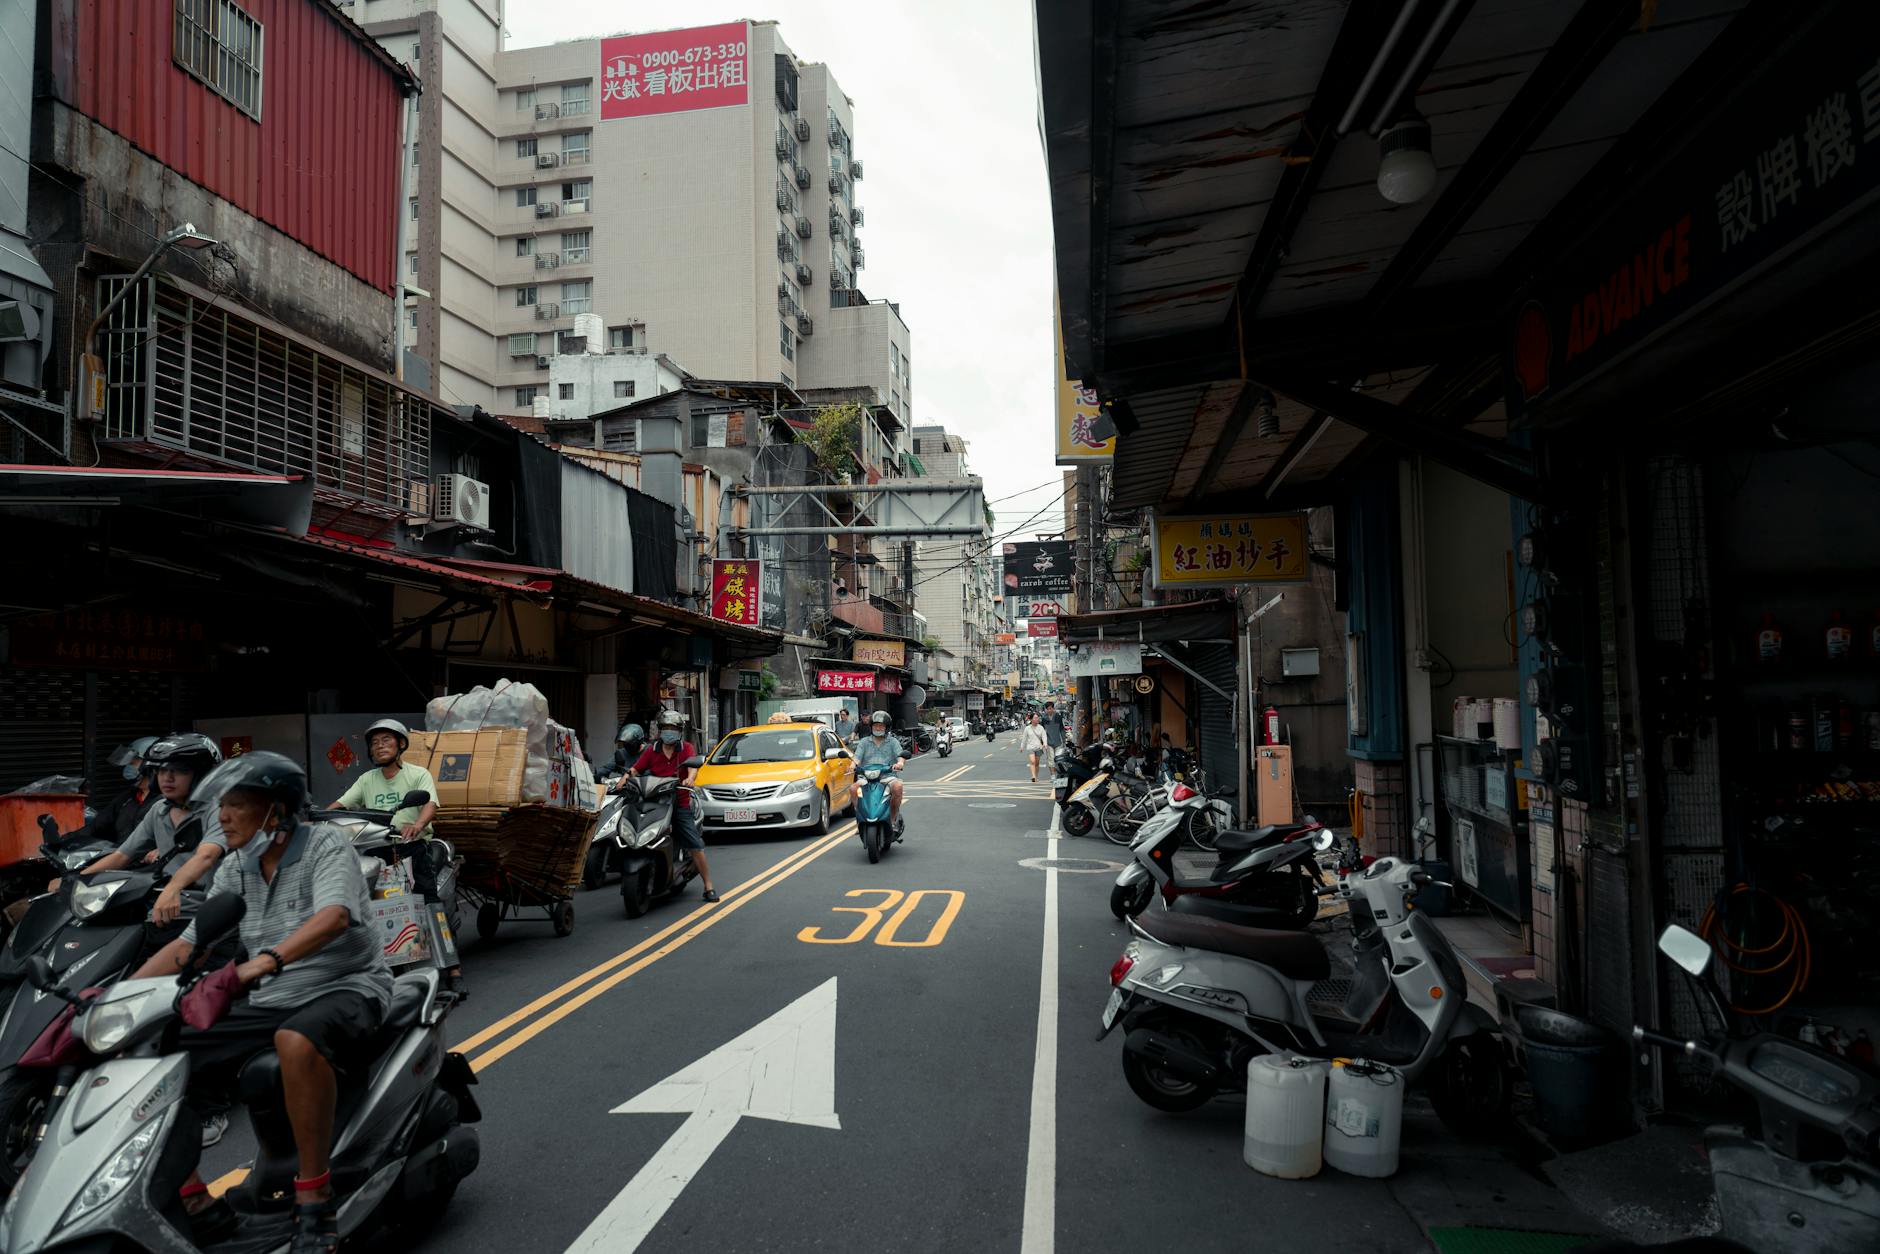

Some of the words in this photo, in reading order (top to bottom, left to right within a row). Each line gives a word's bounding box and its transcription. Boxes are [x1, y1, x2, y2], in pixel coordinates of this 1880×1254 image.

[643, 42, 746, 68] 0900-673-330
[603, 78, 641, 102] 光鈦
[643, 59, 746, 97] 看板出租
[1564, 208, 1693, 367] ADVANCE
[1174, 538, 1290, 572] 紅油抄手
[725, 576, 747, 621] 碳烤
[1020, 578, 1043, 587] carob
[1045, 577, 1069, 586] coffee
[796, 889, 966, 947] 30
